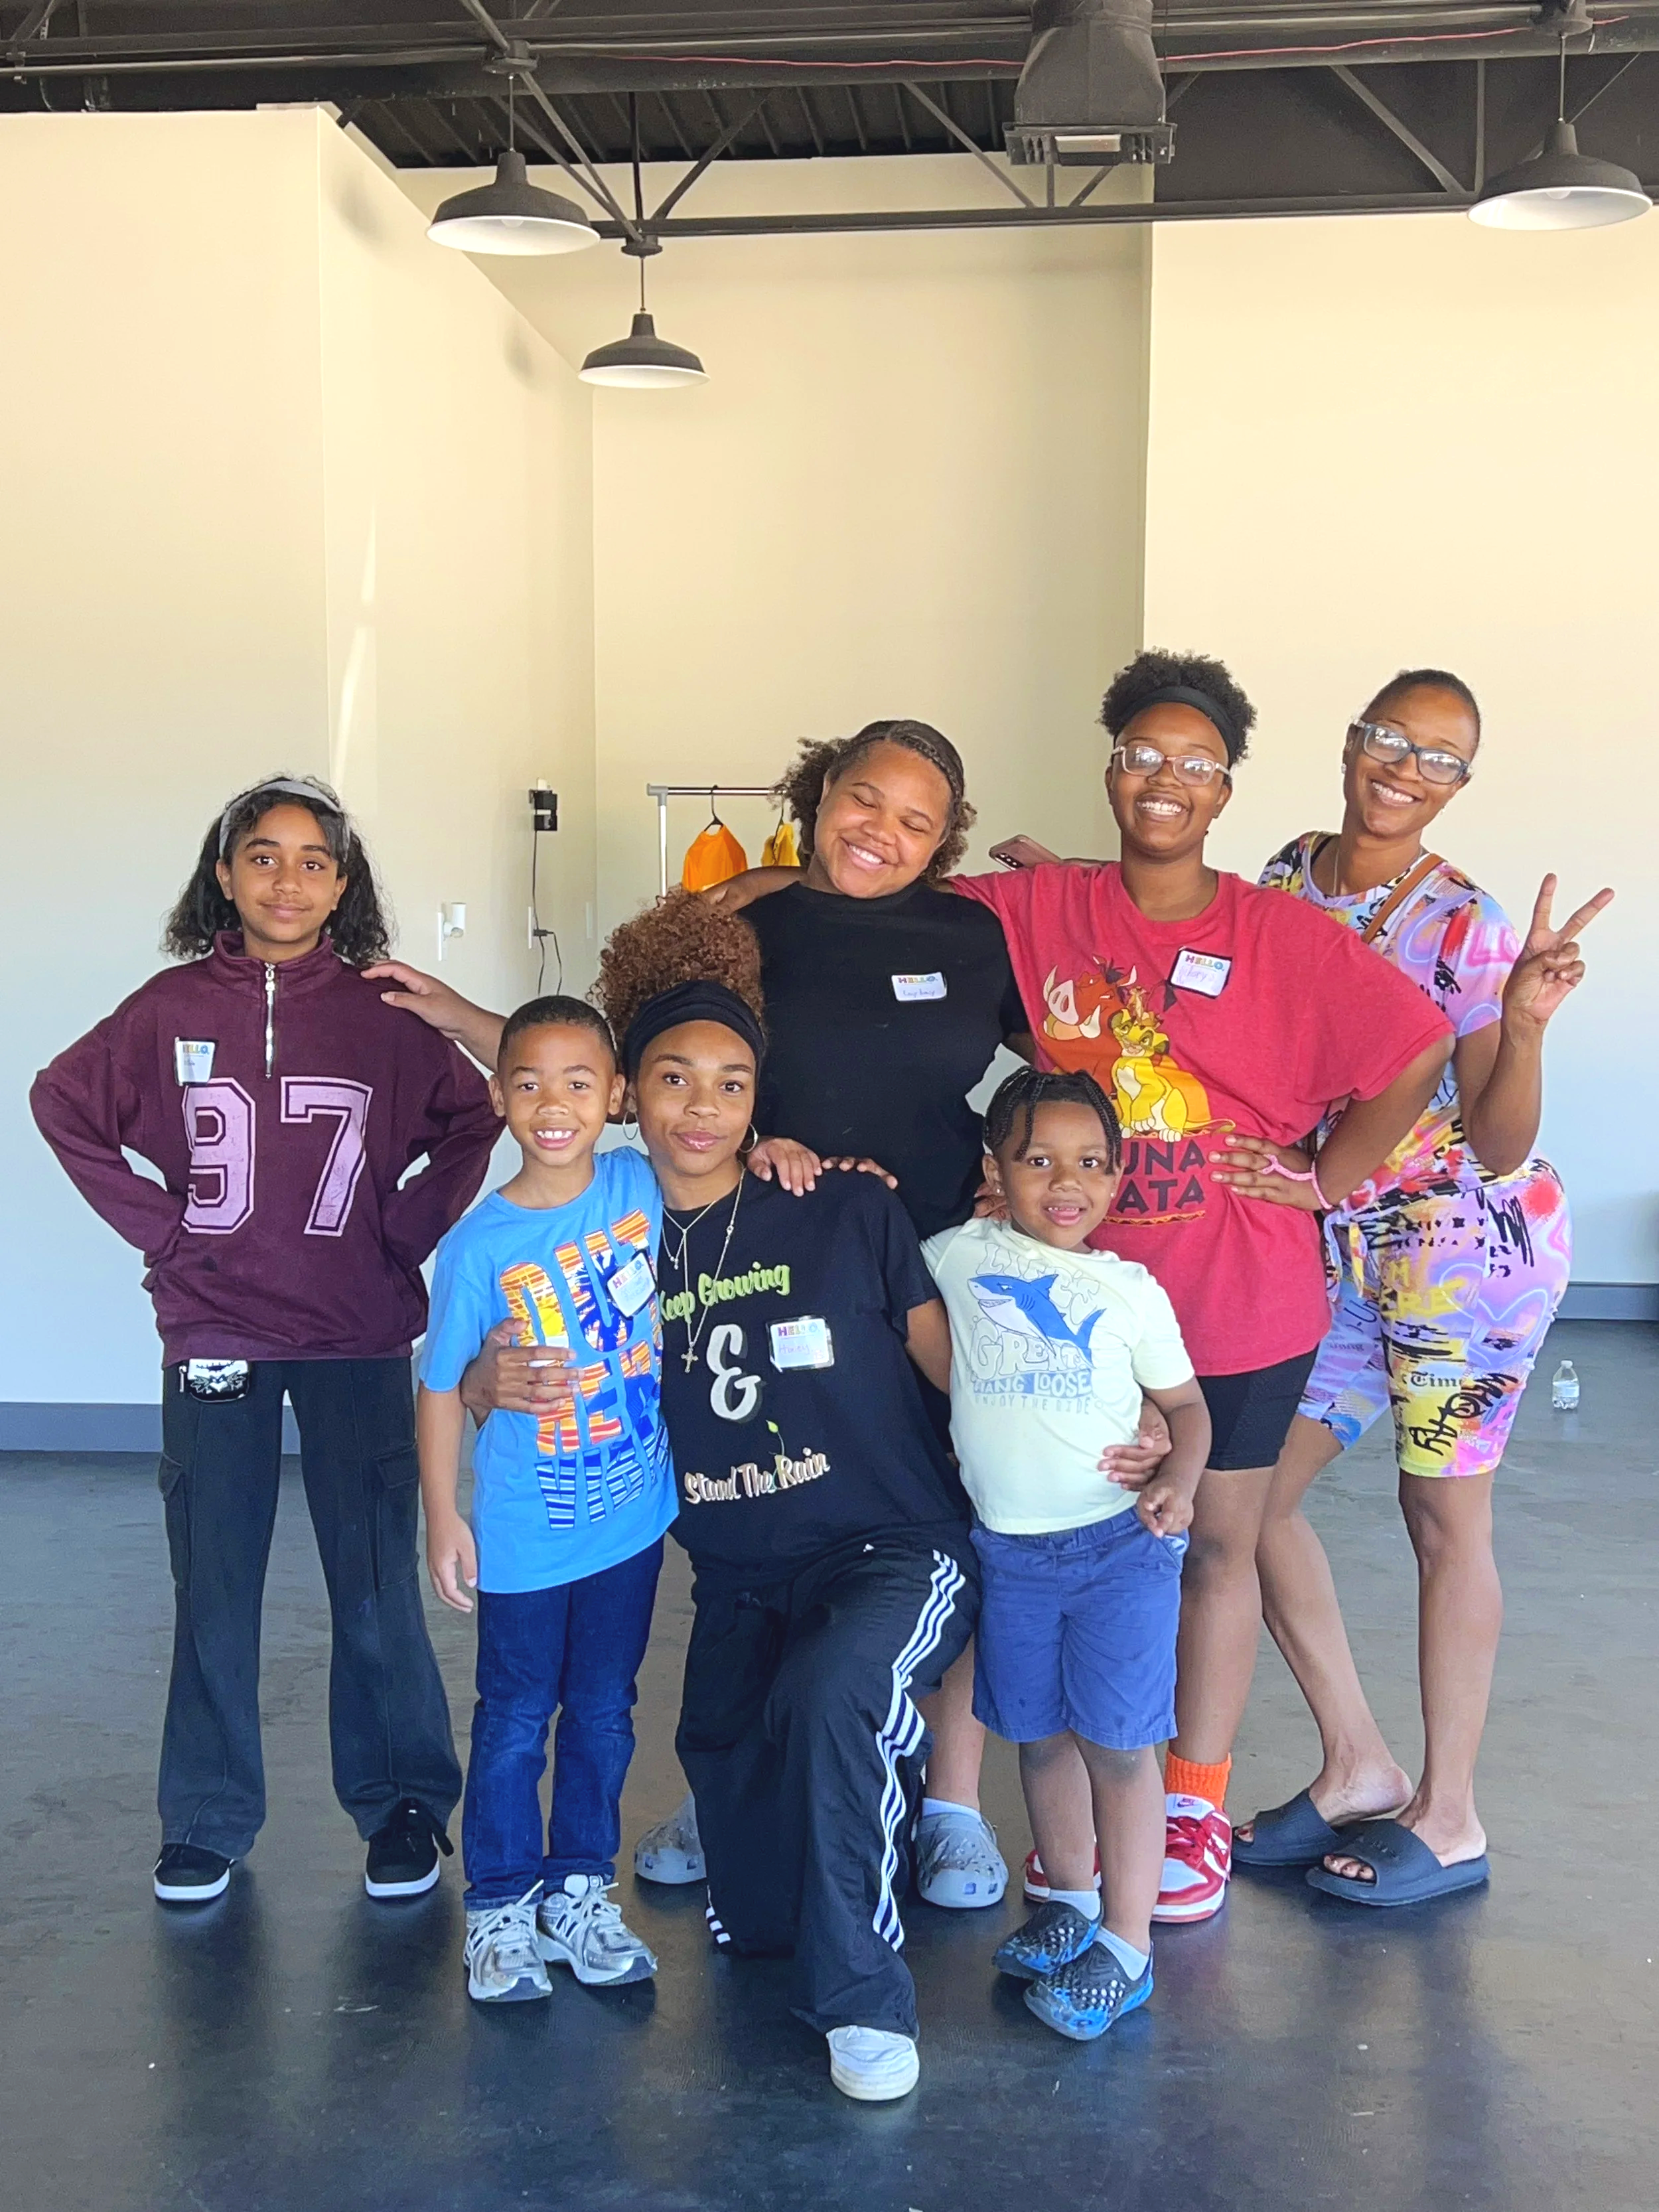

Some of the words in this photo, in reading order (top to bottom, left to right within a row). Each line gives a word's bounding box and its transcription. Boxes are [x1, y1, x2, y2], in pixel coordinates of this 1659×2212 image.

[698, 1261, 790, 1307] Growing
[1033, 1370, 1093, 1398] LOOSE
[1021, 1396, 1050, 1411] THE
[684, 1465, 741, 1505] Stand
[737, 1462, 776, 1498] The
[774, 1447, 831, 1489] Rain
